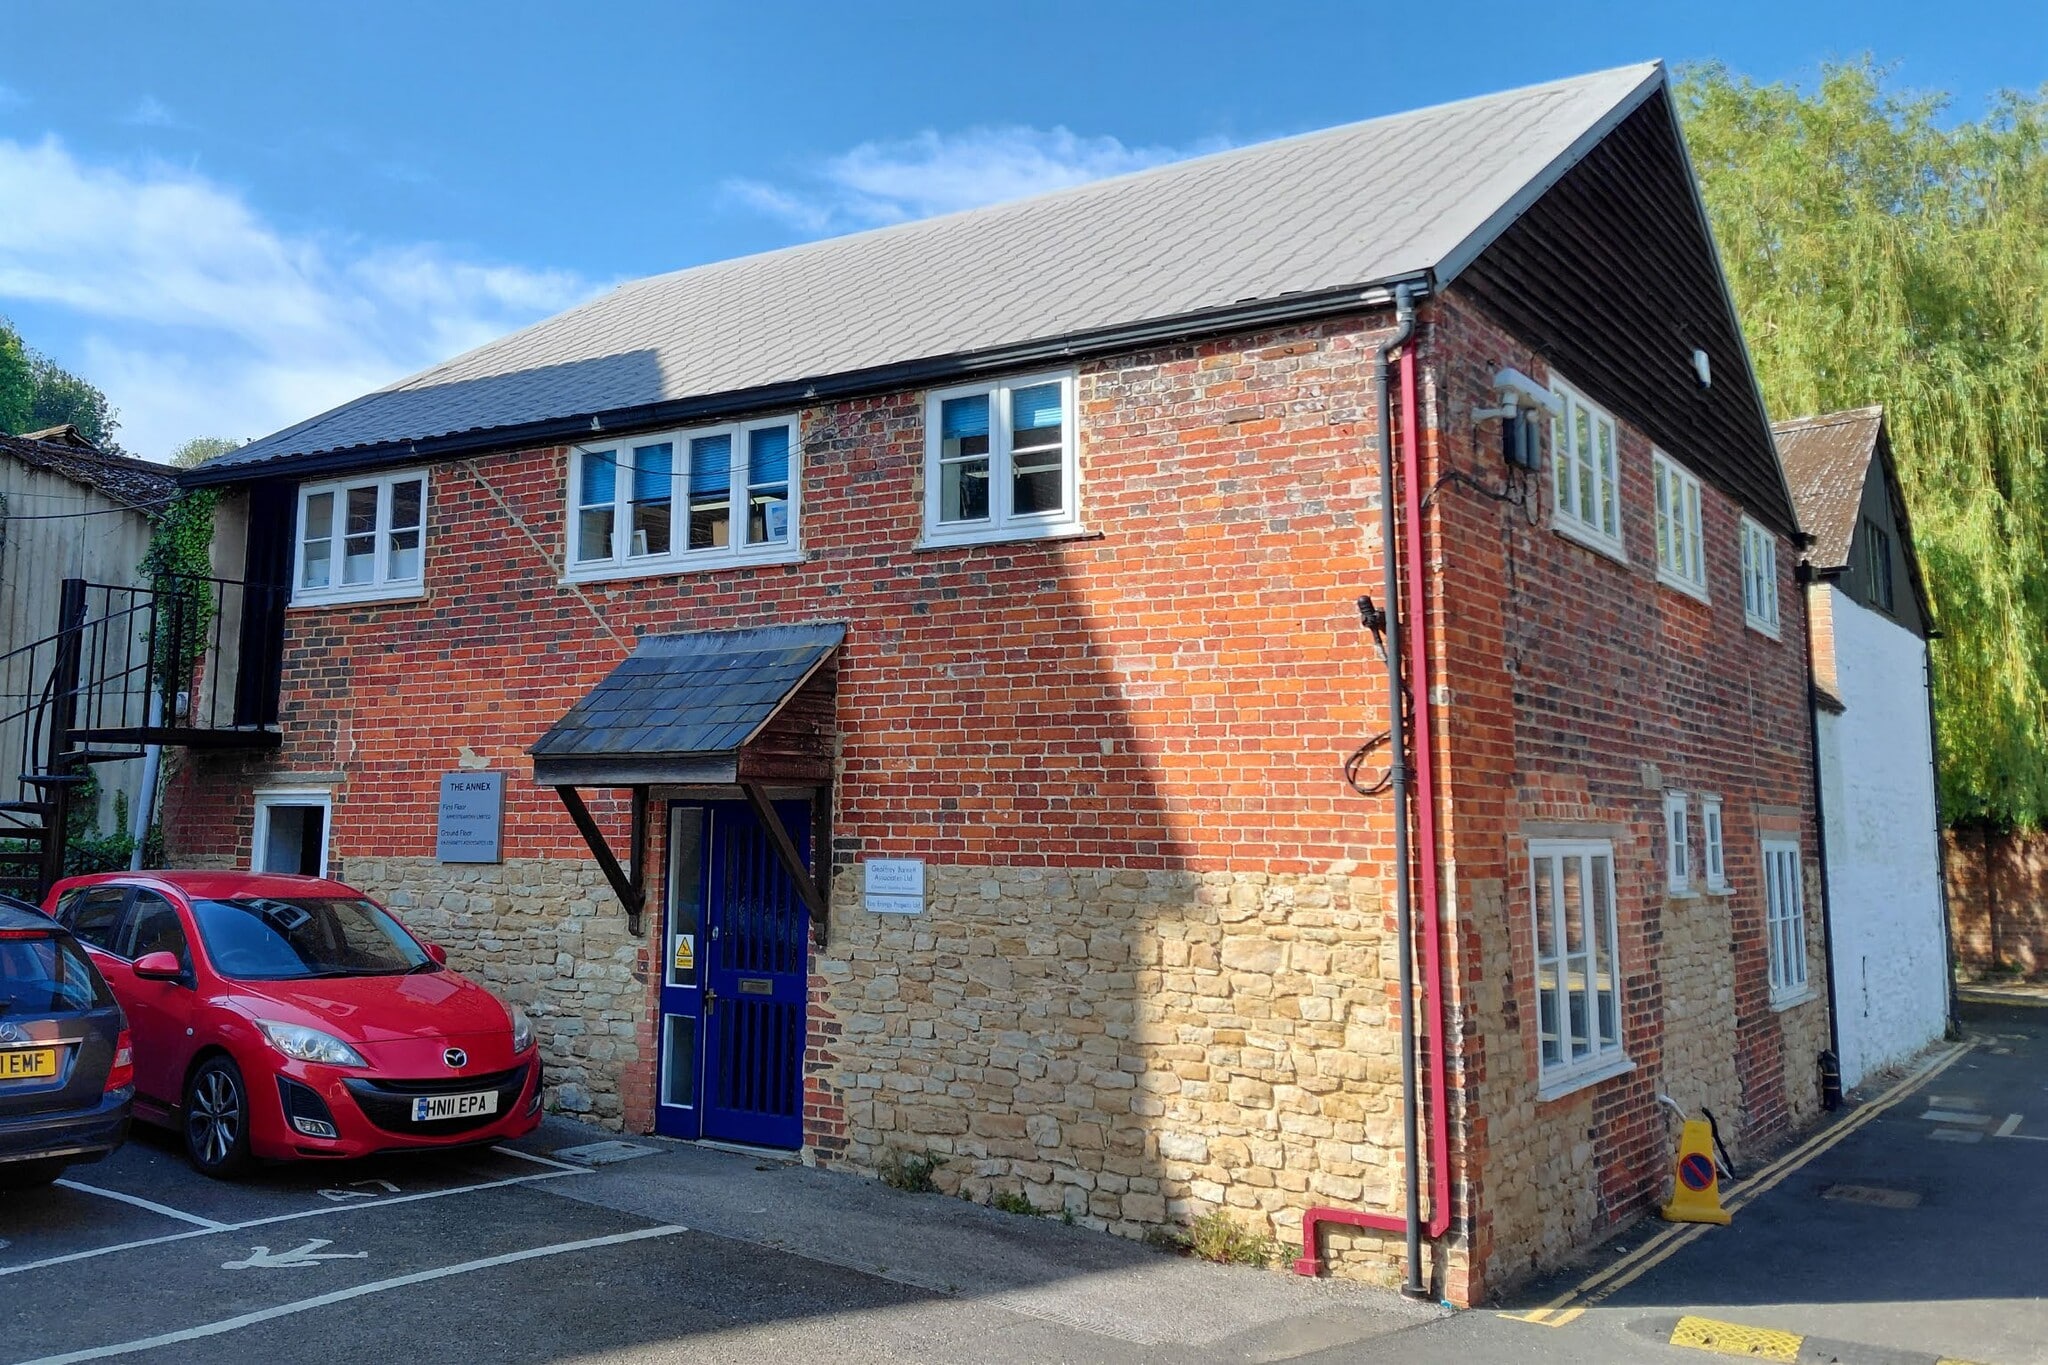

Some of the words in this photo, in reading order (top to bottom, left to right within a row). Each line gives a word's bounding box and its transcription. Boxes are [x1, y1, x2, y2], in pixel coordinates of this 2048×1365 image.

[450, 783, 464, 791] THE
[466, 783, 491, 791] ANNEX
[10, 1053, 45, 1073] EMF
[426, 1098, 456, 1117] HN11
[459, 1095, 486, 1114] EPA
